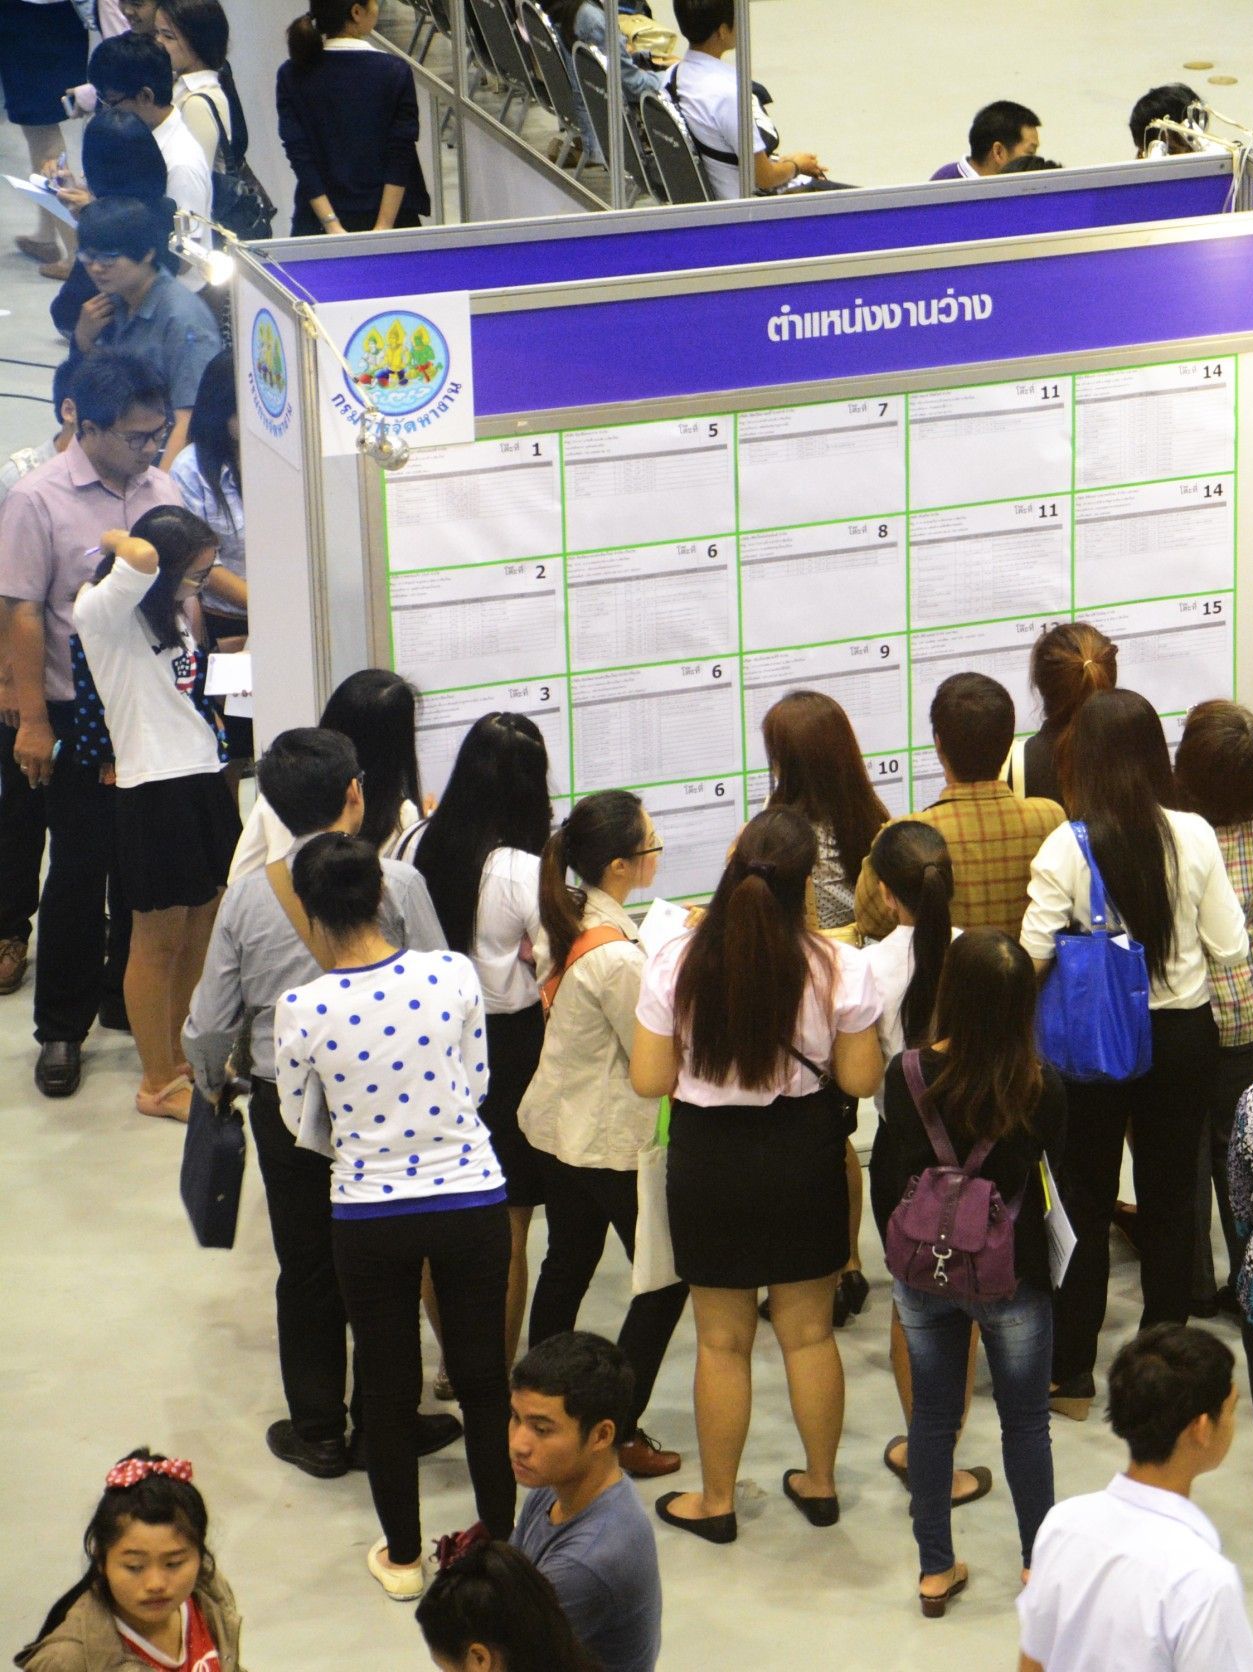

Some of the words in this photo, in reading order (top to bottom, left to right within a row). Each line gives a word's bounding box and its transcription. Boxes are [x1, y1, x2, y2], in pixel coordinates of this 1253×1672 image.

[767, 288, 993, 343] ตำแหน่งงานว่าง
[1203, 363, 1223, 379] 14
[1041, 384, 1060, 400] 11
[878, 402, 889, 417] 7
[708, 422, 719, 438] 5
[532, 442, 542, 457] 1
[1203, 483, 1224, 499] 14
[1039, 503, 1058, 519] 11
[878, 524, 888, 539] 8
[707, 543, 718, 559] 6
[535, 564, 546, 580] 2
[1202, 600, 1222, 616] 15
[1040, 622, 1059, 635] 1
[879, 644, 890, 659] 9
[711, 664, 723, 679] 6
[540, 686, 551, 702] 3
[878, 759, 899, 775] 10
[714, 782, 725, 797] 6
